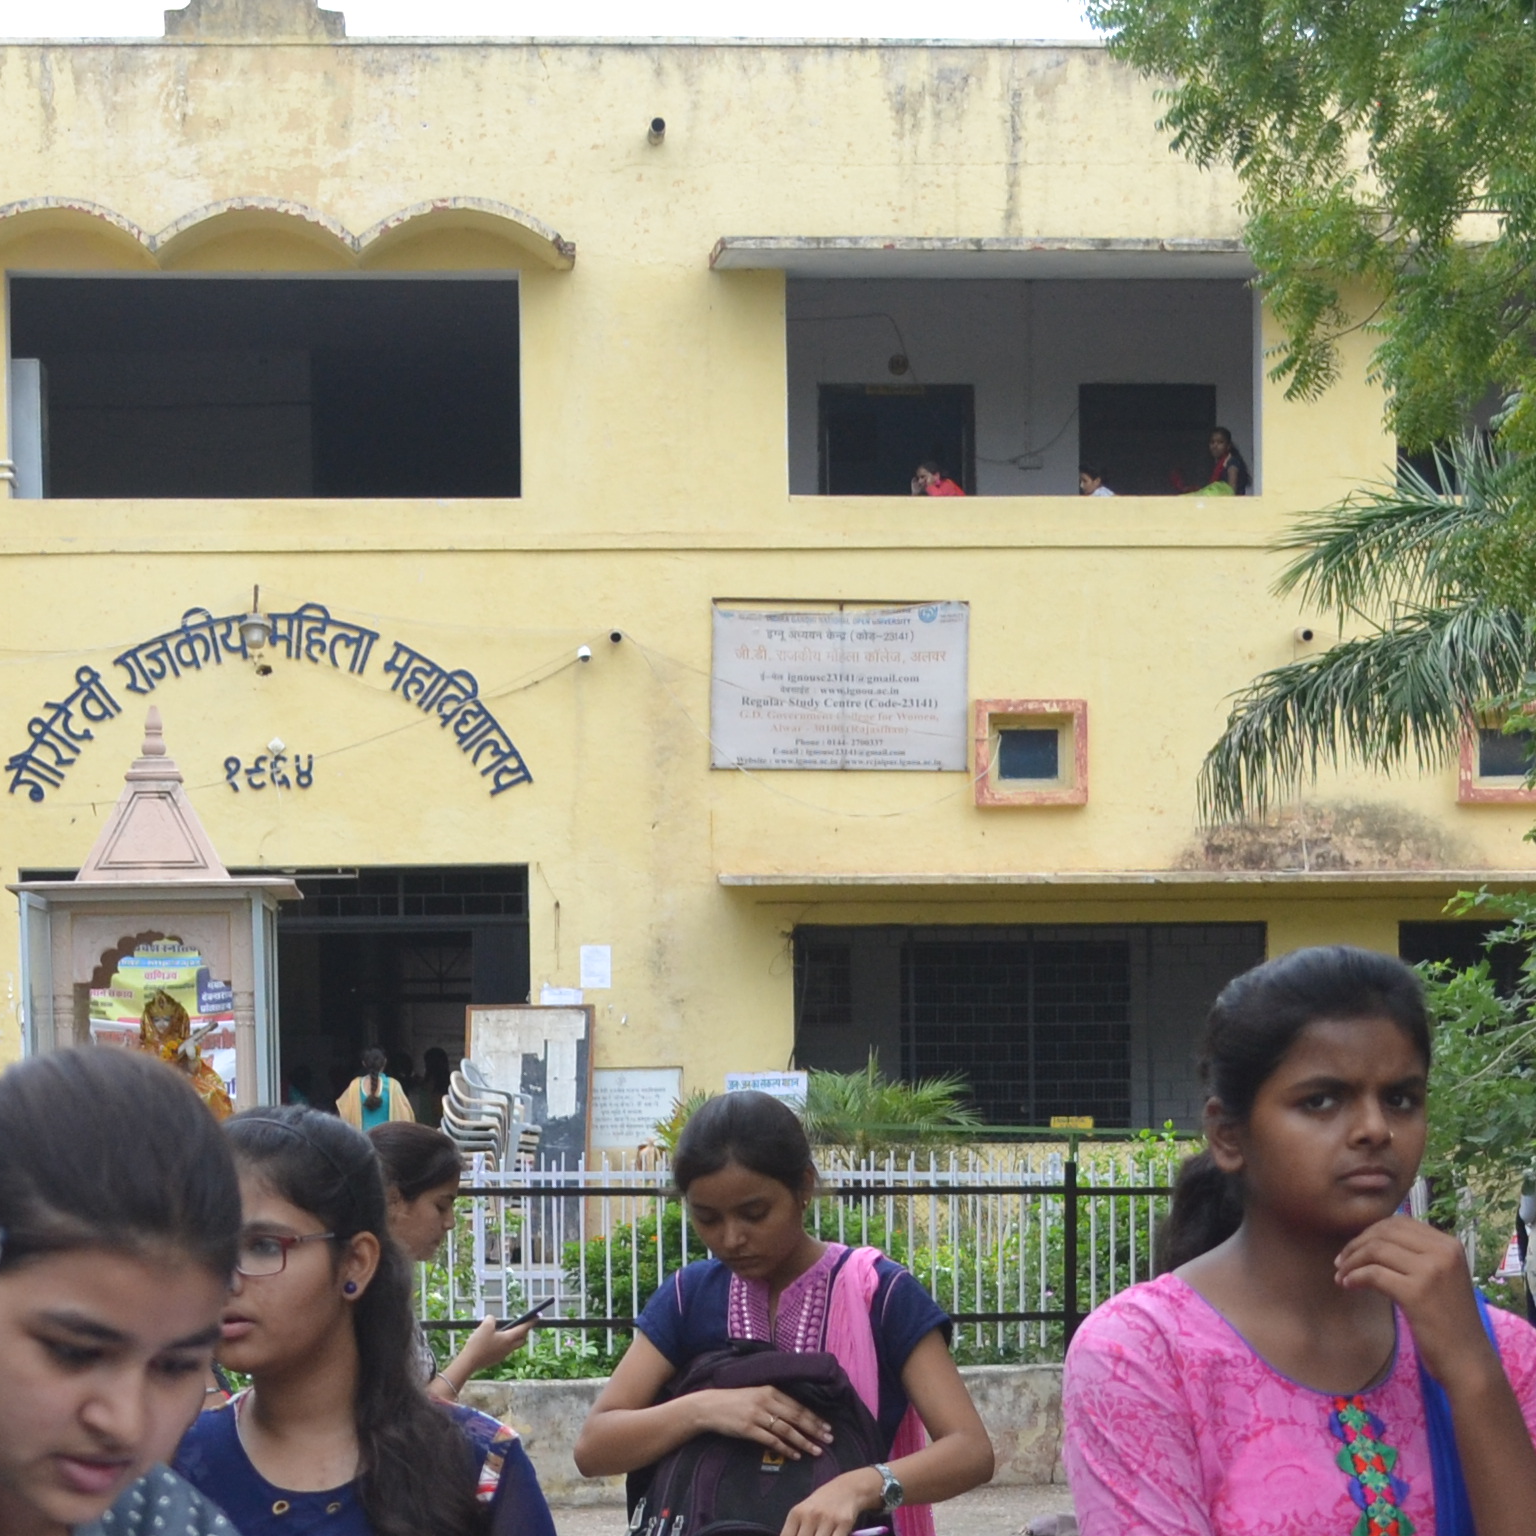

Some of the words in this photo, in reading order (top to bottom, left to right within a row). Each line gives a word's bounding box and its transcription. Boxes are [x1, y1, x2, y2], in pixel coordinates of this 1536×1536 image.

[4, 665, 122, 803] गौरीदेवी
[113, 607, 248, 695] राजकीय
[268, 602, 380, 675] महिला
[384, 641, 533, 797] महाविद्यालय
[741, 697, 784, 708] Regular
[789, 698, 820, 711] Study
[824, 698, 862, 708] Centre
